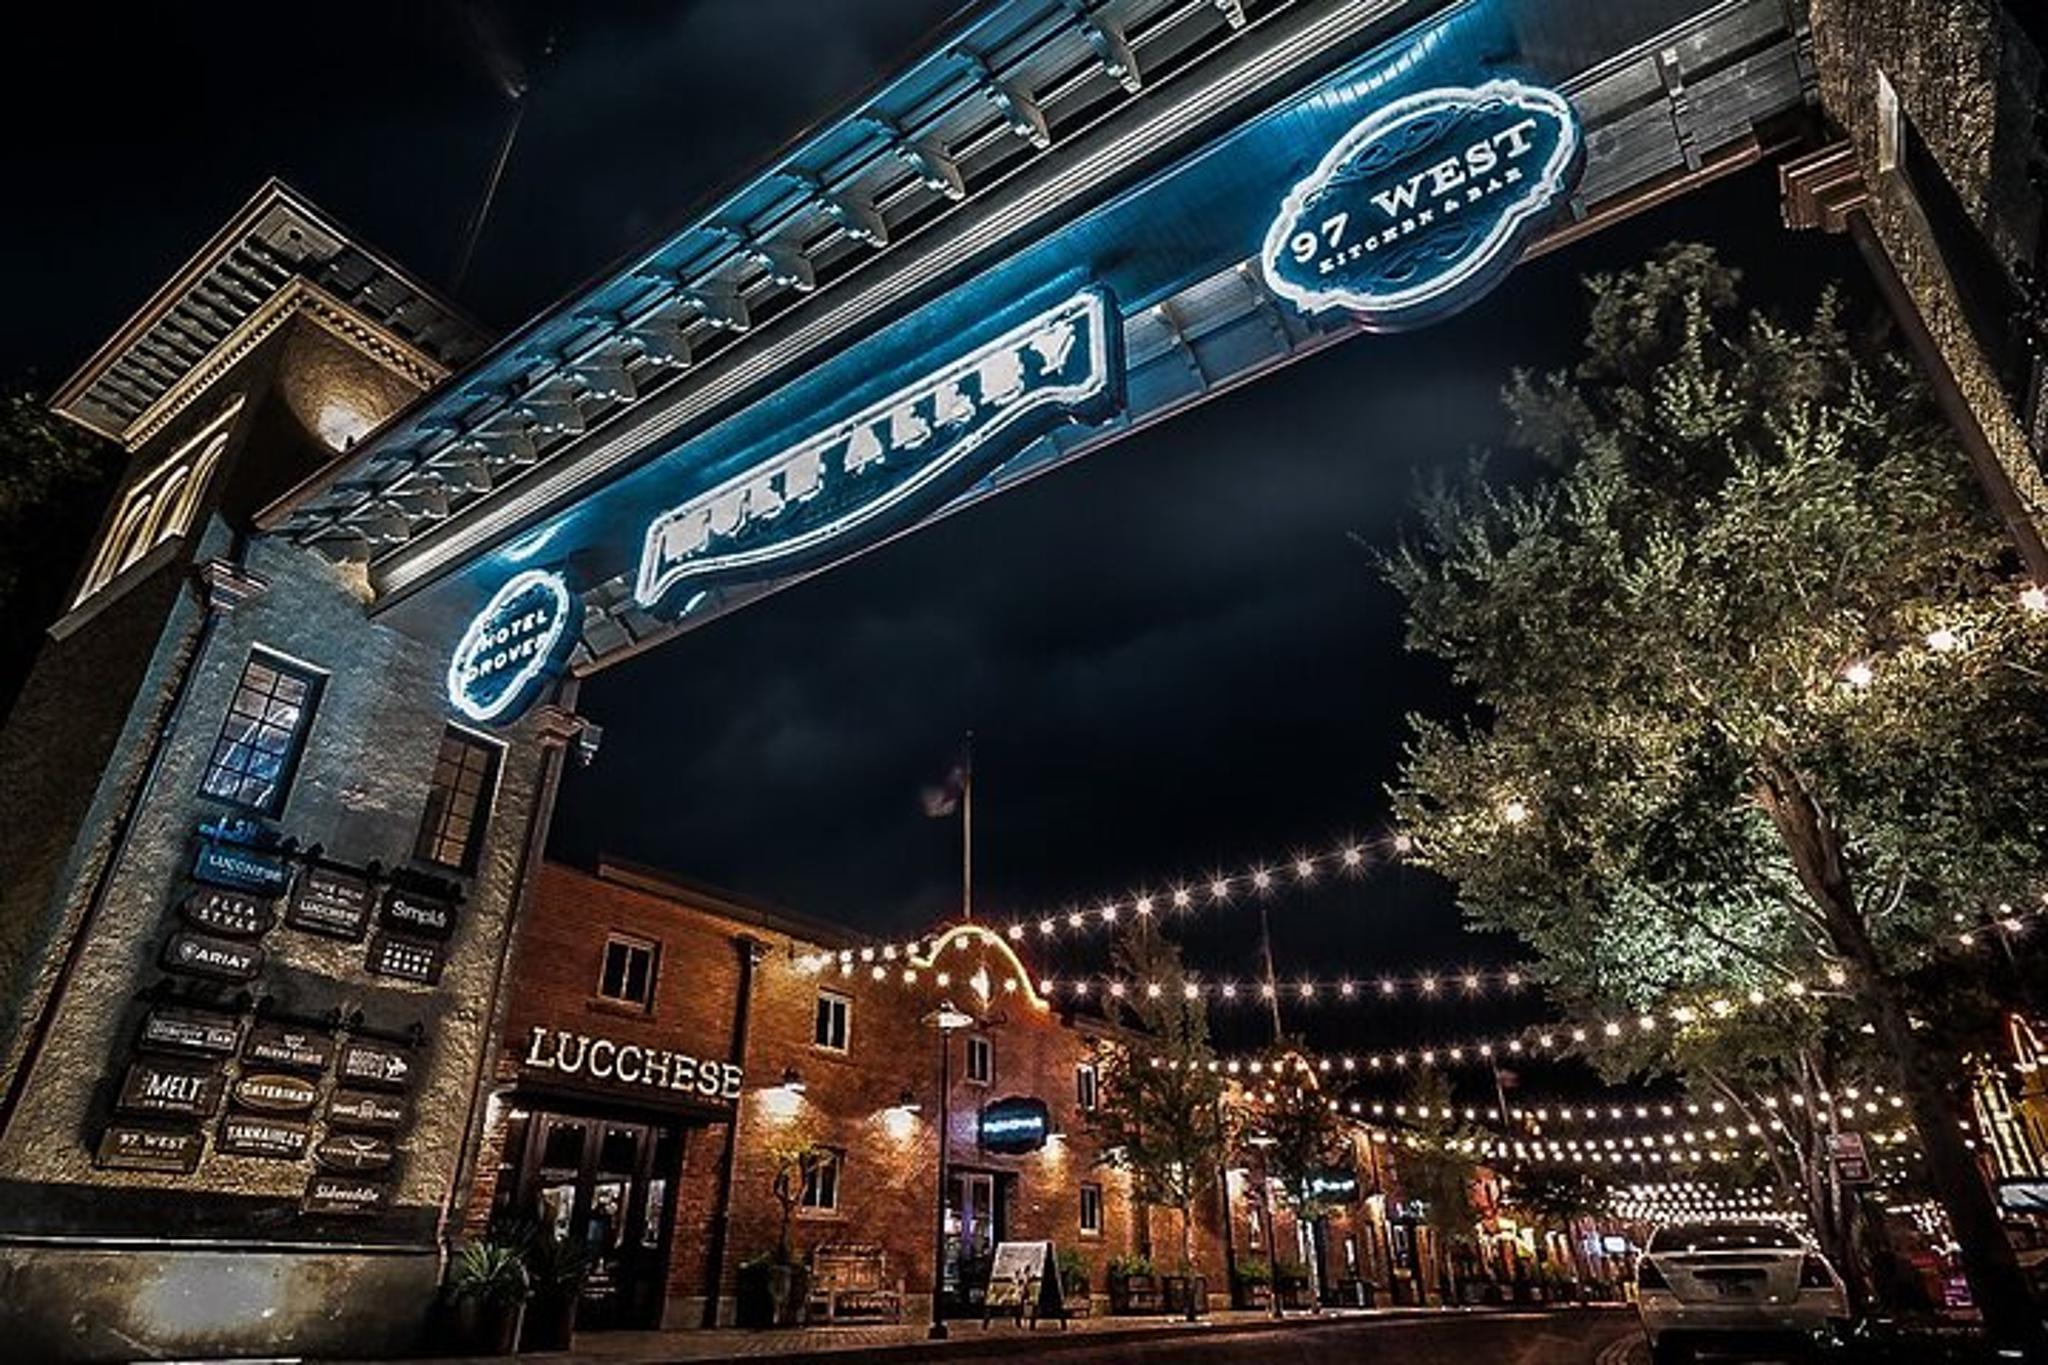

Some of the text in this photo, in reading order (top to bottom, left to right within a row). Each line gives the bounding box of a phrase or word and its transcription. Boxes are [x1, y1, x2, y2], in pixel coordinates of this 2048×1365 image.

[1291, 118, 1537, 263] 97 WEST
[1318, 210, 1434, 275] KITCHEN
[1466, 167, 1523, 203] BAR
[480, 610, 548, 652] HOTEL
[196, 949, 251, 970] ARIAT
[525, 1026, 743, 1099] LUCCHESE
[146, 1073, 208, 1102] MELT
[144, 1134, 188, 1150] WEST
